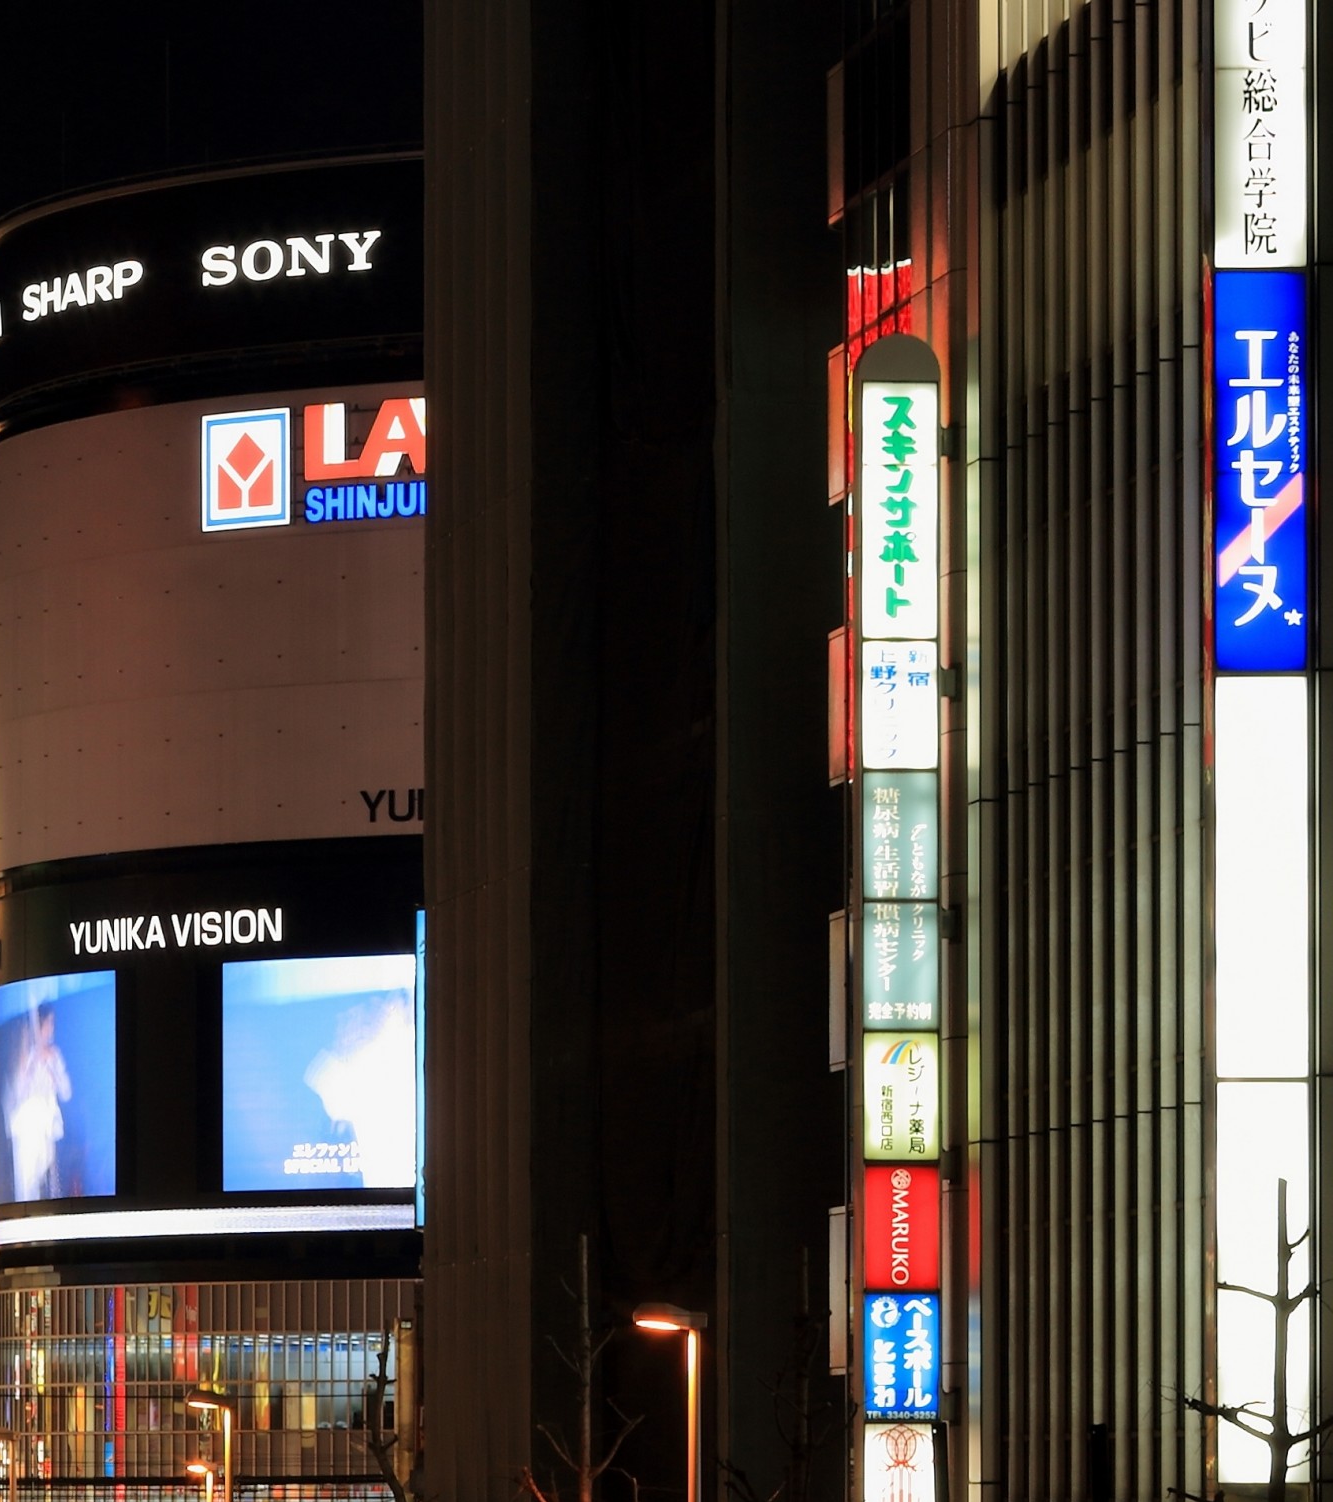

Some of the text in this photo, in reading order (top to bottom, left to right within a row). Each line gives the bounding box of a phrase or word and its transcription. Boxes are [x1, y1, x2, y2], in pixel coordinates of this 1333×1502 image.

[1242, 0, 1279, 256] ビ総合学院
[22, 259, 144, 322] SHARP
[201, 230, 382, 287] SONY
[878, 396, 920, 618] スキンサポート
[1226, 329, 1288, 628] エルセーヌ
[69, 907, 283, 956] YUNIKA VISION
[907, 1043, 926, 1155] レジーナ薬局
[891, 1188, 910, 1286] MARUKO
